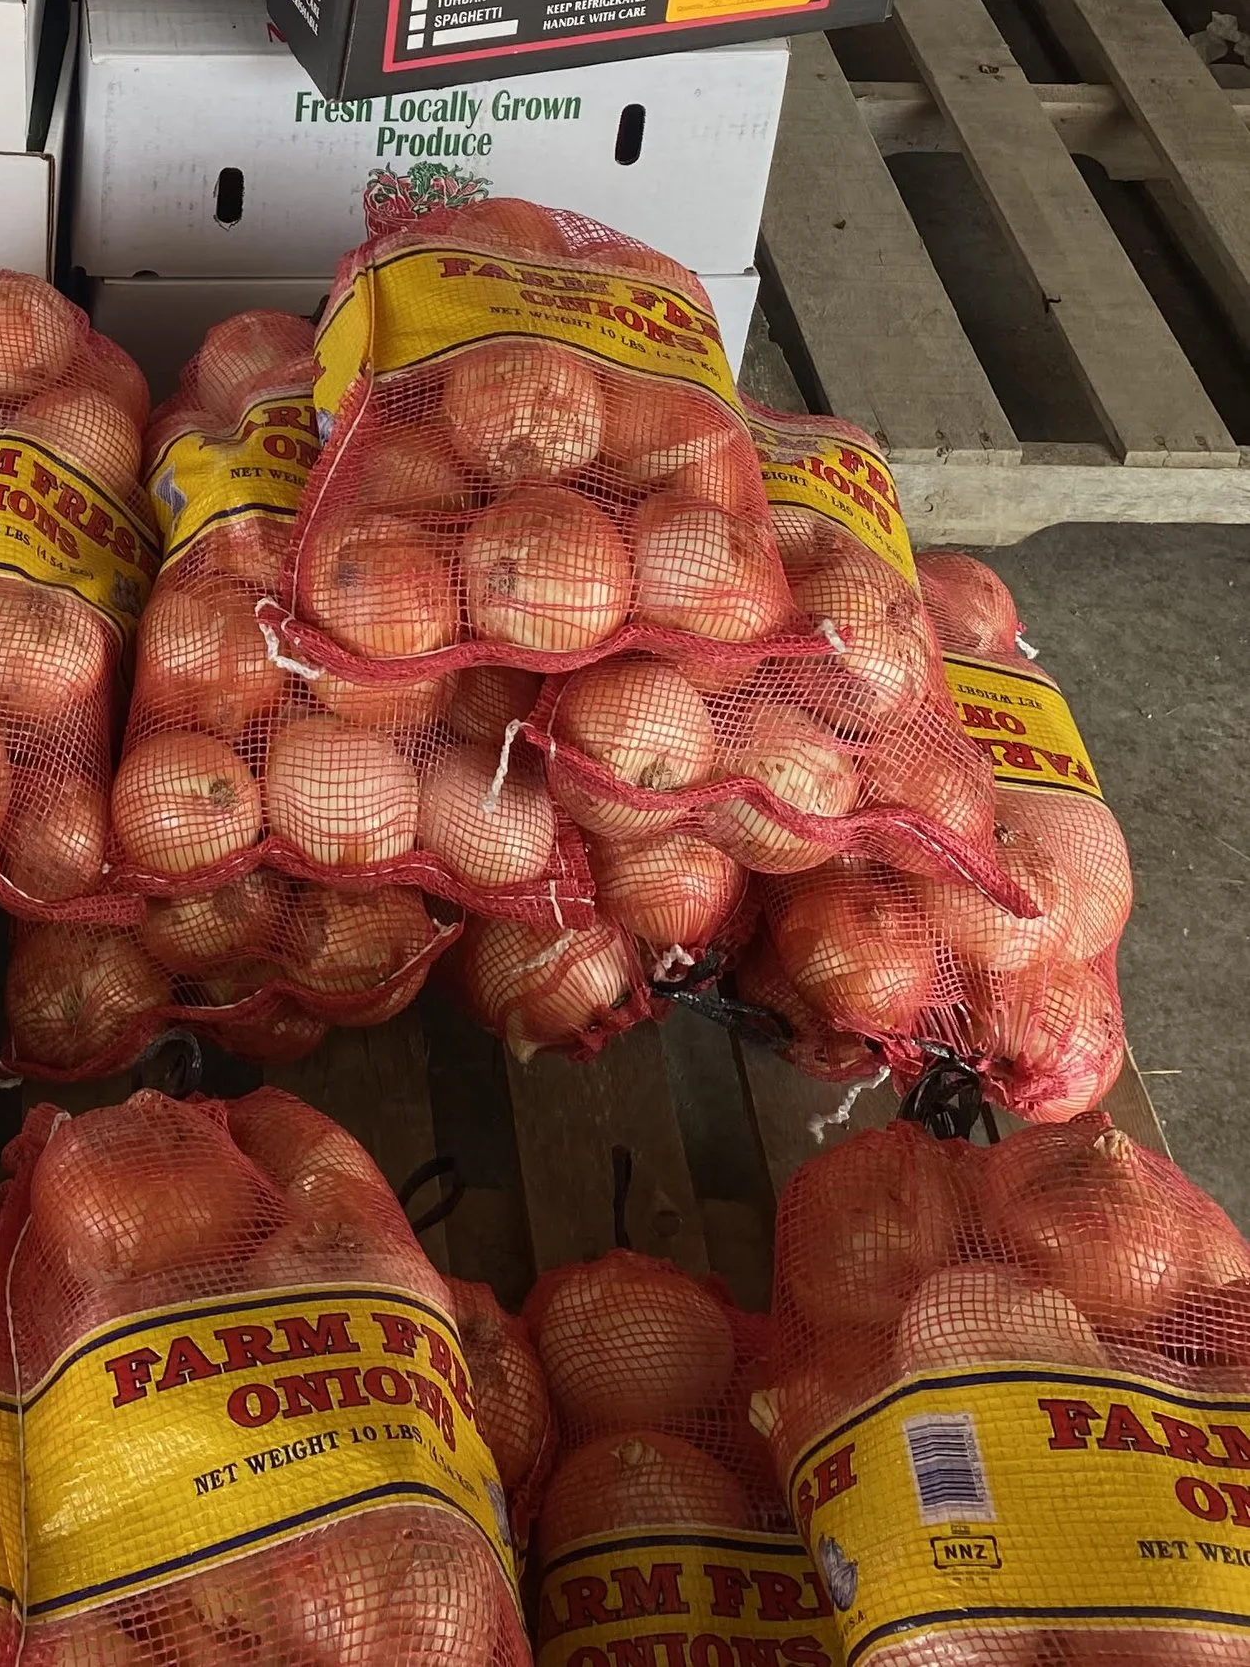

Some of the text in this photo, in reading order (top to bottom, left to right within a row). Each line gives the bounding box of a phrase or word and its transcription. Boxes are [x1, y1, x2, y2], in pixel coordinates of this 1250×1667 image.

[434, 6, 503, 28] SPAGHETTI
[542, 7, 647, 30] HANDLE WITH CARE
[546, 2, 573, 15] KEEP
[295, 89, 582, 129] Fresh Locally Grown
[376, 126, 492, 157] Produce
[490, 305, 592, 332] NET WEIGHT
[229, 467, 263, 480] NET
[957, 684, 1044, 710] NET WEIGHT
[105, 1312, 362, 1409] FARM
[227, 1364, 457, 1453] ONIONS
[193, 1424, 378, 1497] NET WEIGHT 10
[943, 1543, 990, 1561] NNZ
[1137, 1539, 1189, 1560] NET
